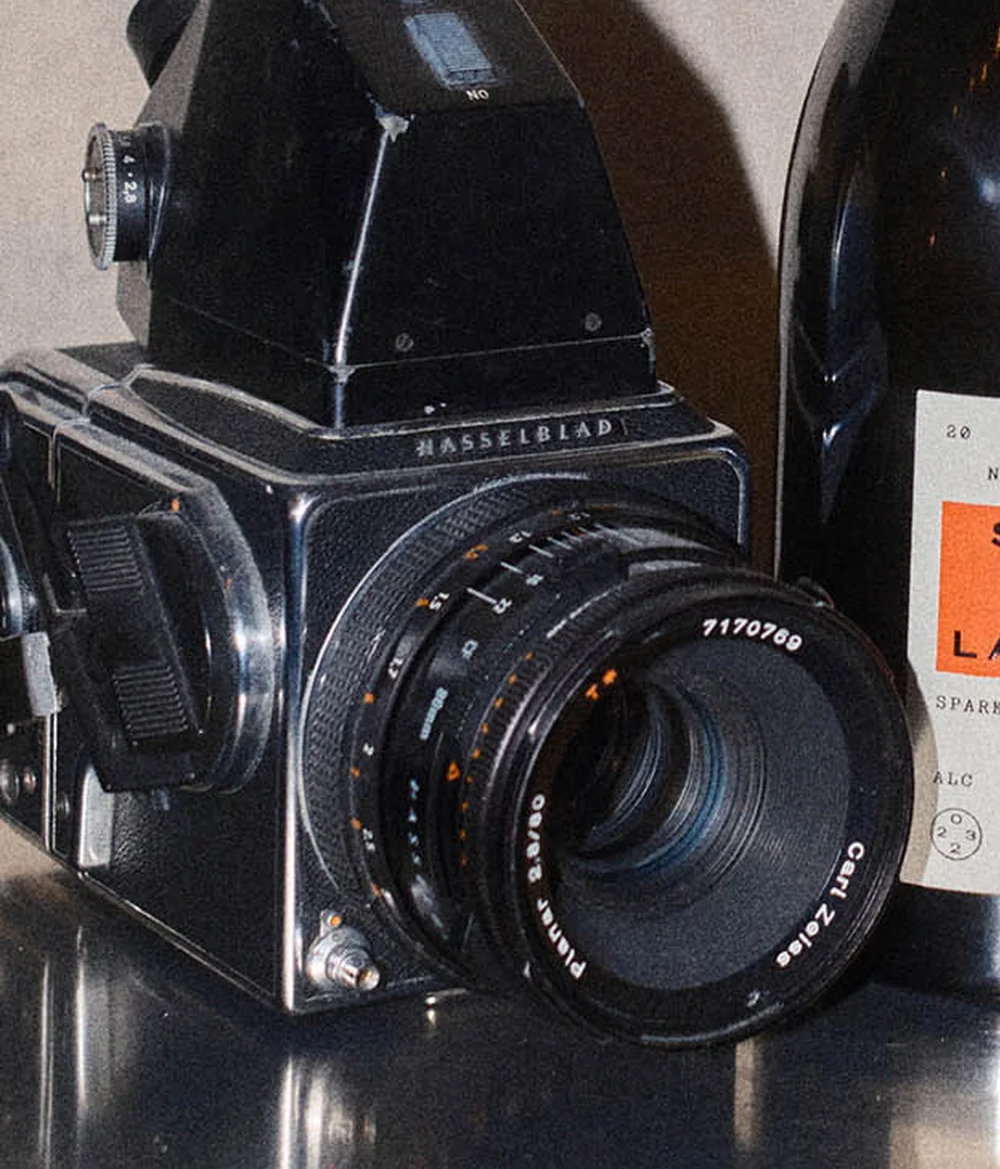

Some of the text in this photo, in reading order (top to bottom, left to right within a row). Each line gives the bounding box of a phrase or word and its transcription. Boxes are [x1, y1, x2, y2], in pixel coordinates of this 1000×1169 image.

[416, 419, 612, 457] HASSELBLAD
[946, 424, 971, 440] 20
[702, 618, 802, 651] 7170769
[932, 770, 973, 787] ALC
[830, 841, 865, 900] Carl
